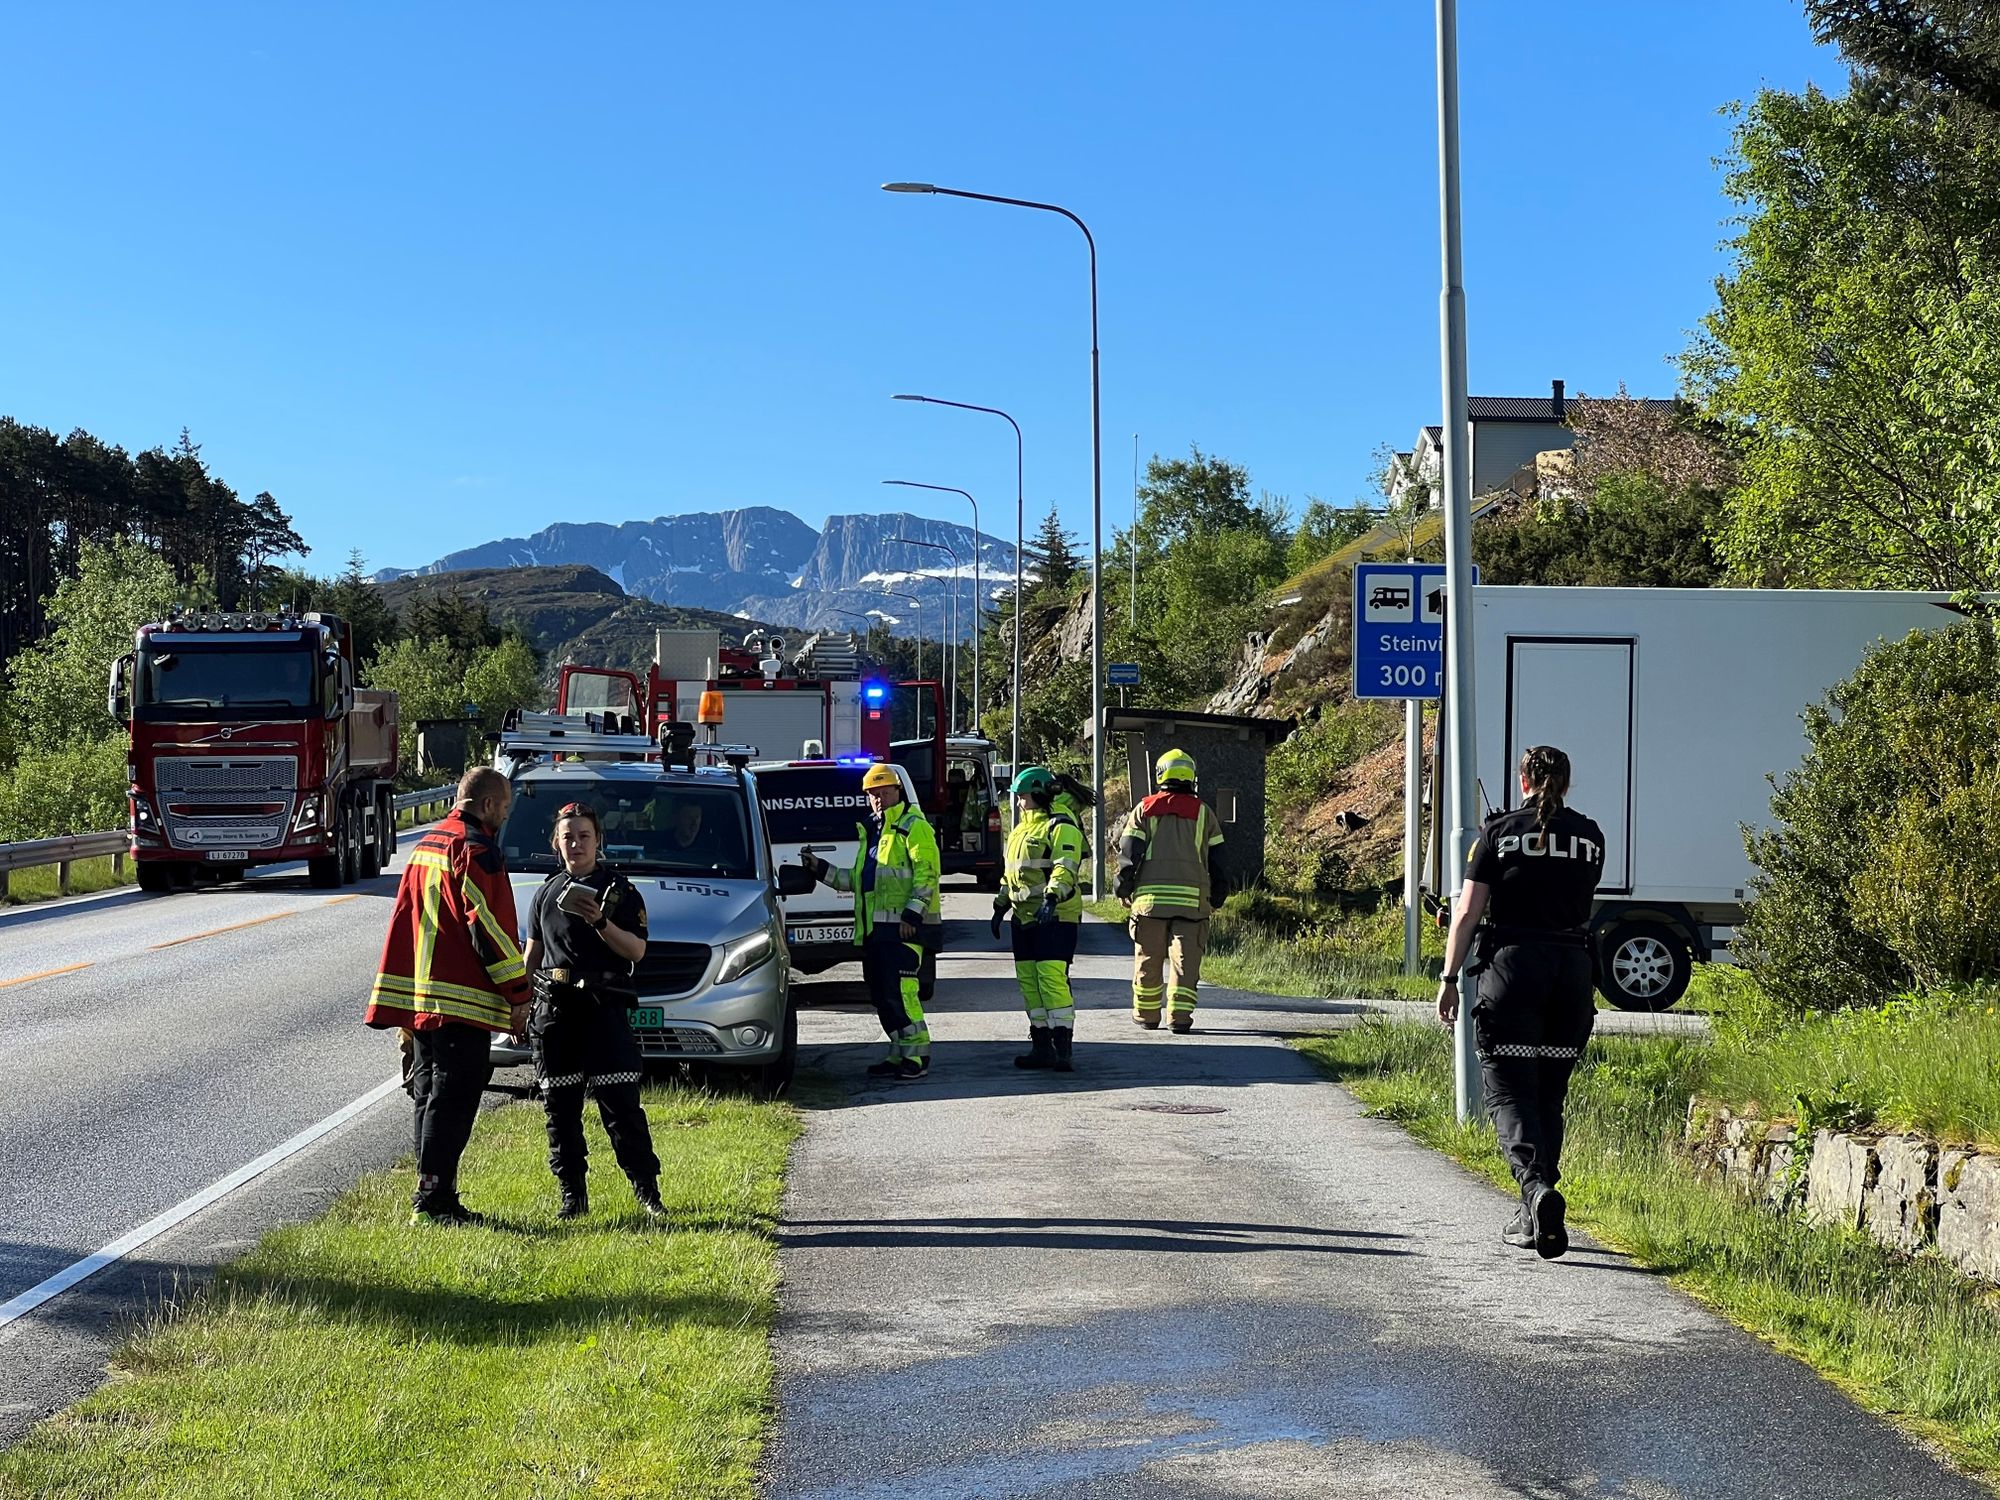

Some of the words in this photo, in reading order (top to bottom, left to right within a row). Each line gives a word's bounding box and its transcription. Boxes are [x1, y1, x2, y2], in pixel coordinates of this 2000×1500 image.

[1380, 634, 1442, 652] Steinvi
[1380, 665, 1426, 686] 300
[761, 795, 871, 811] NNSATSLEDE
[659, 880, 730, 897] Linja
[797, 929, 813, 940] UA
[819, 928, 855, 940] 35667
[630, 1010, 658, 1025] 688
